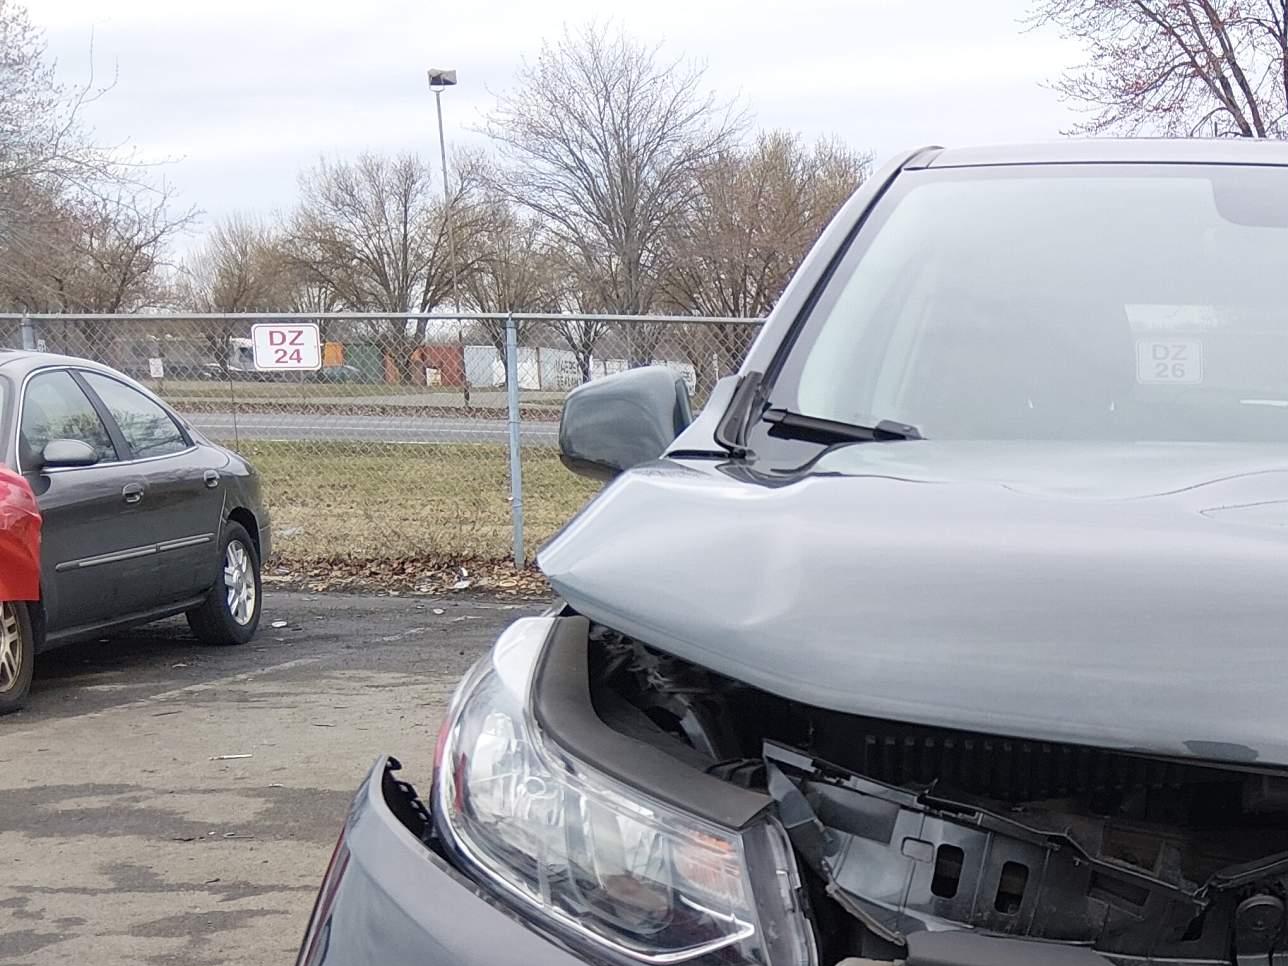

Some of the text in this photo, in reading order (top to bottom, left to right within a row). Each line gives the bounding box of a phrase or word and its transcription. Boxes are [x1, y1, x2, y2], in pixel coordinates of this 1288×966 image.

[268, 330, 305, 346] DZ
[274, 348, 304, 364] 24
[1151, 343, 1188, 361] DZ
[1154, 362, 1186, 378] 26
